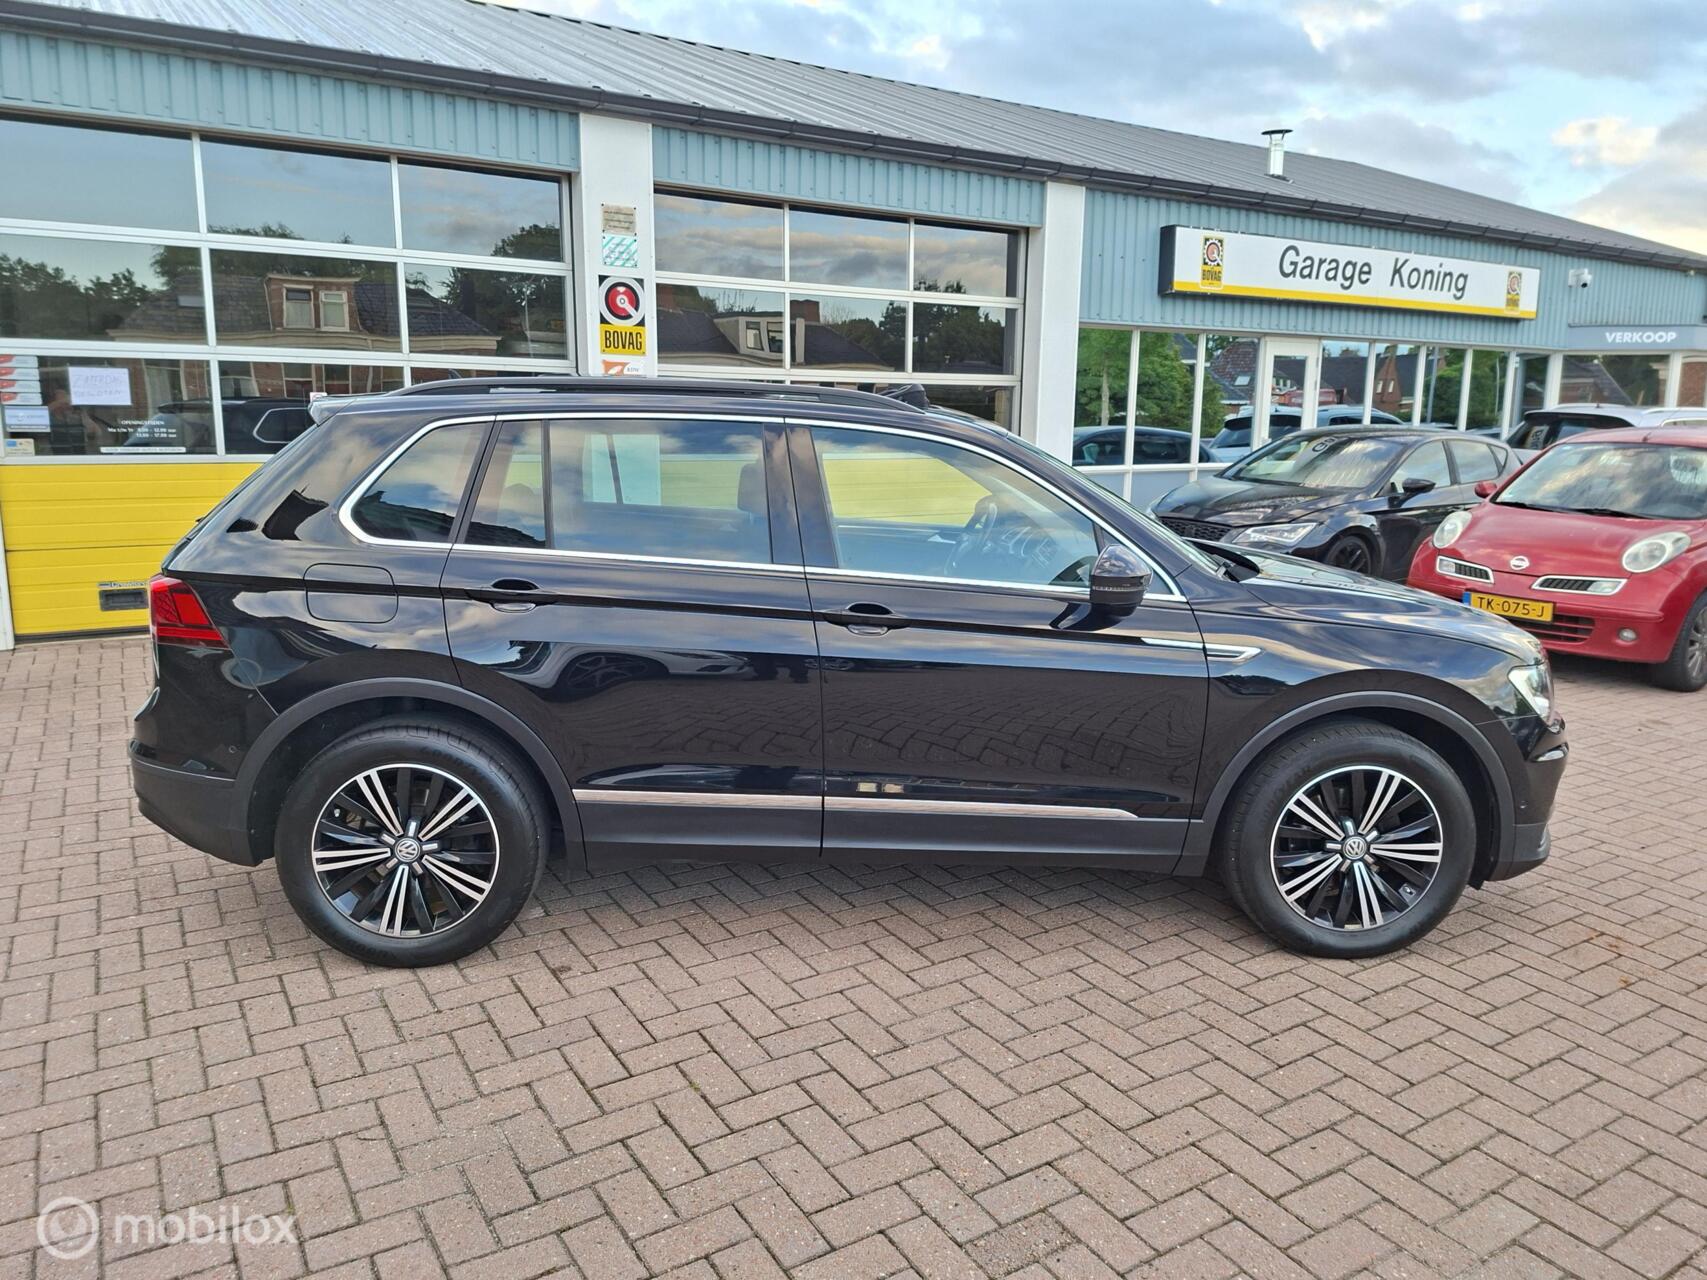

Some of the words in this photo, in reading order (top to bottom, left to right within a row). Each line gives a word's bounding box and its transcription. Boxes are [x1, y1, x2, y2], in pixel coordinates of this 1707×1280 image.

[1202, 269, 1223, 282] BOVAG
[1279, 245, 1372, 290] Garage
[1389, 257, 1469, 300] Koning
[604, 329, 643, 351] BOVAG
[1605, 331, 1677, 343] VERKOOP
[1477, 596, 1545, 618] TK-075-J
